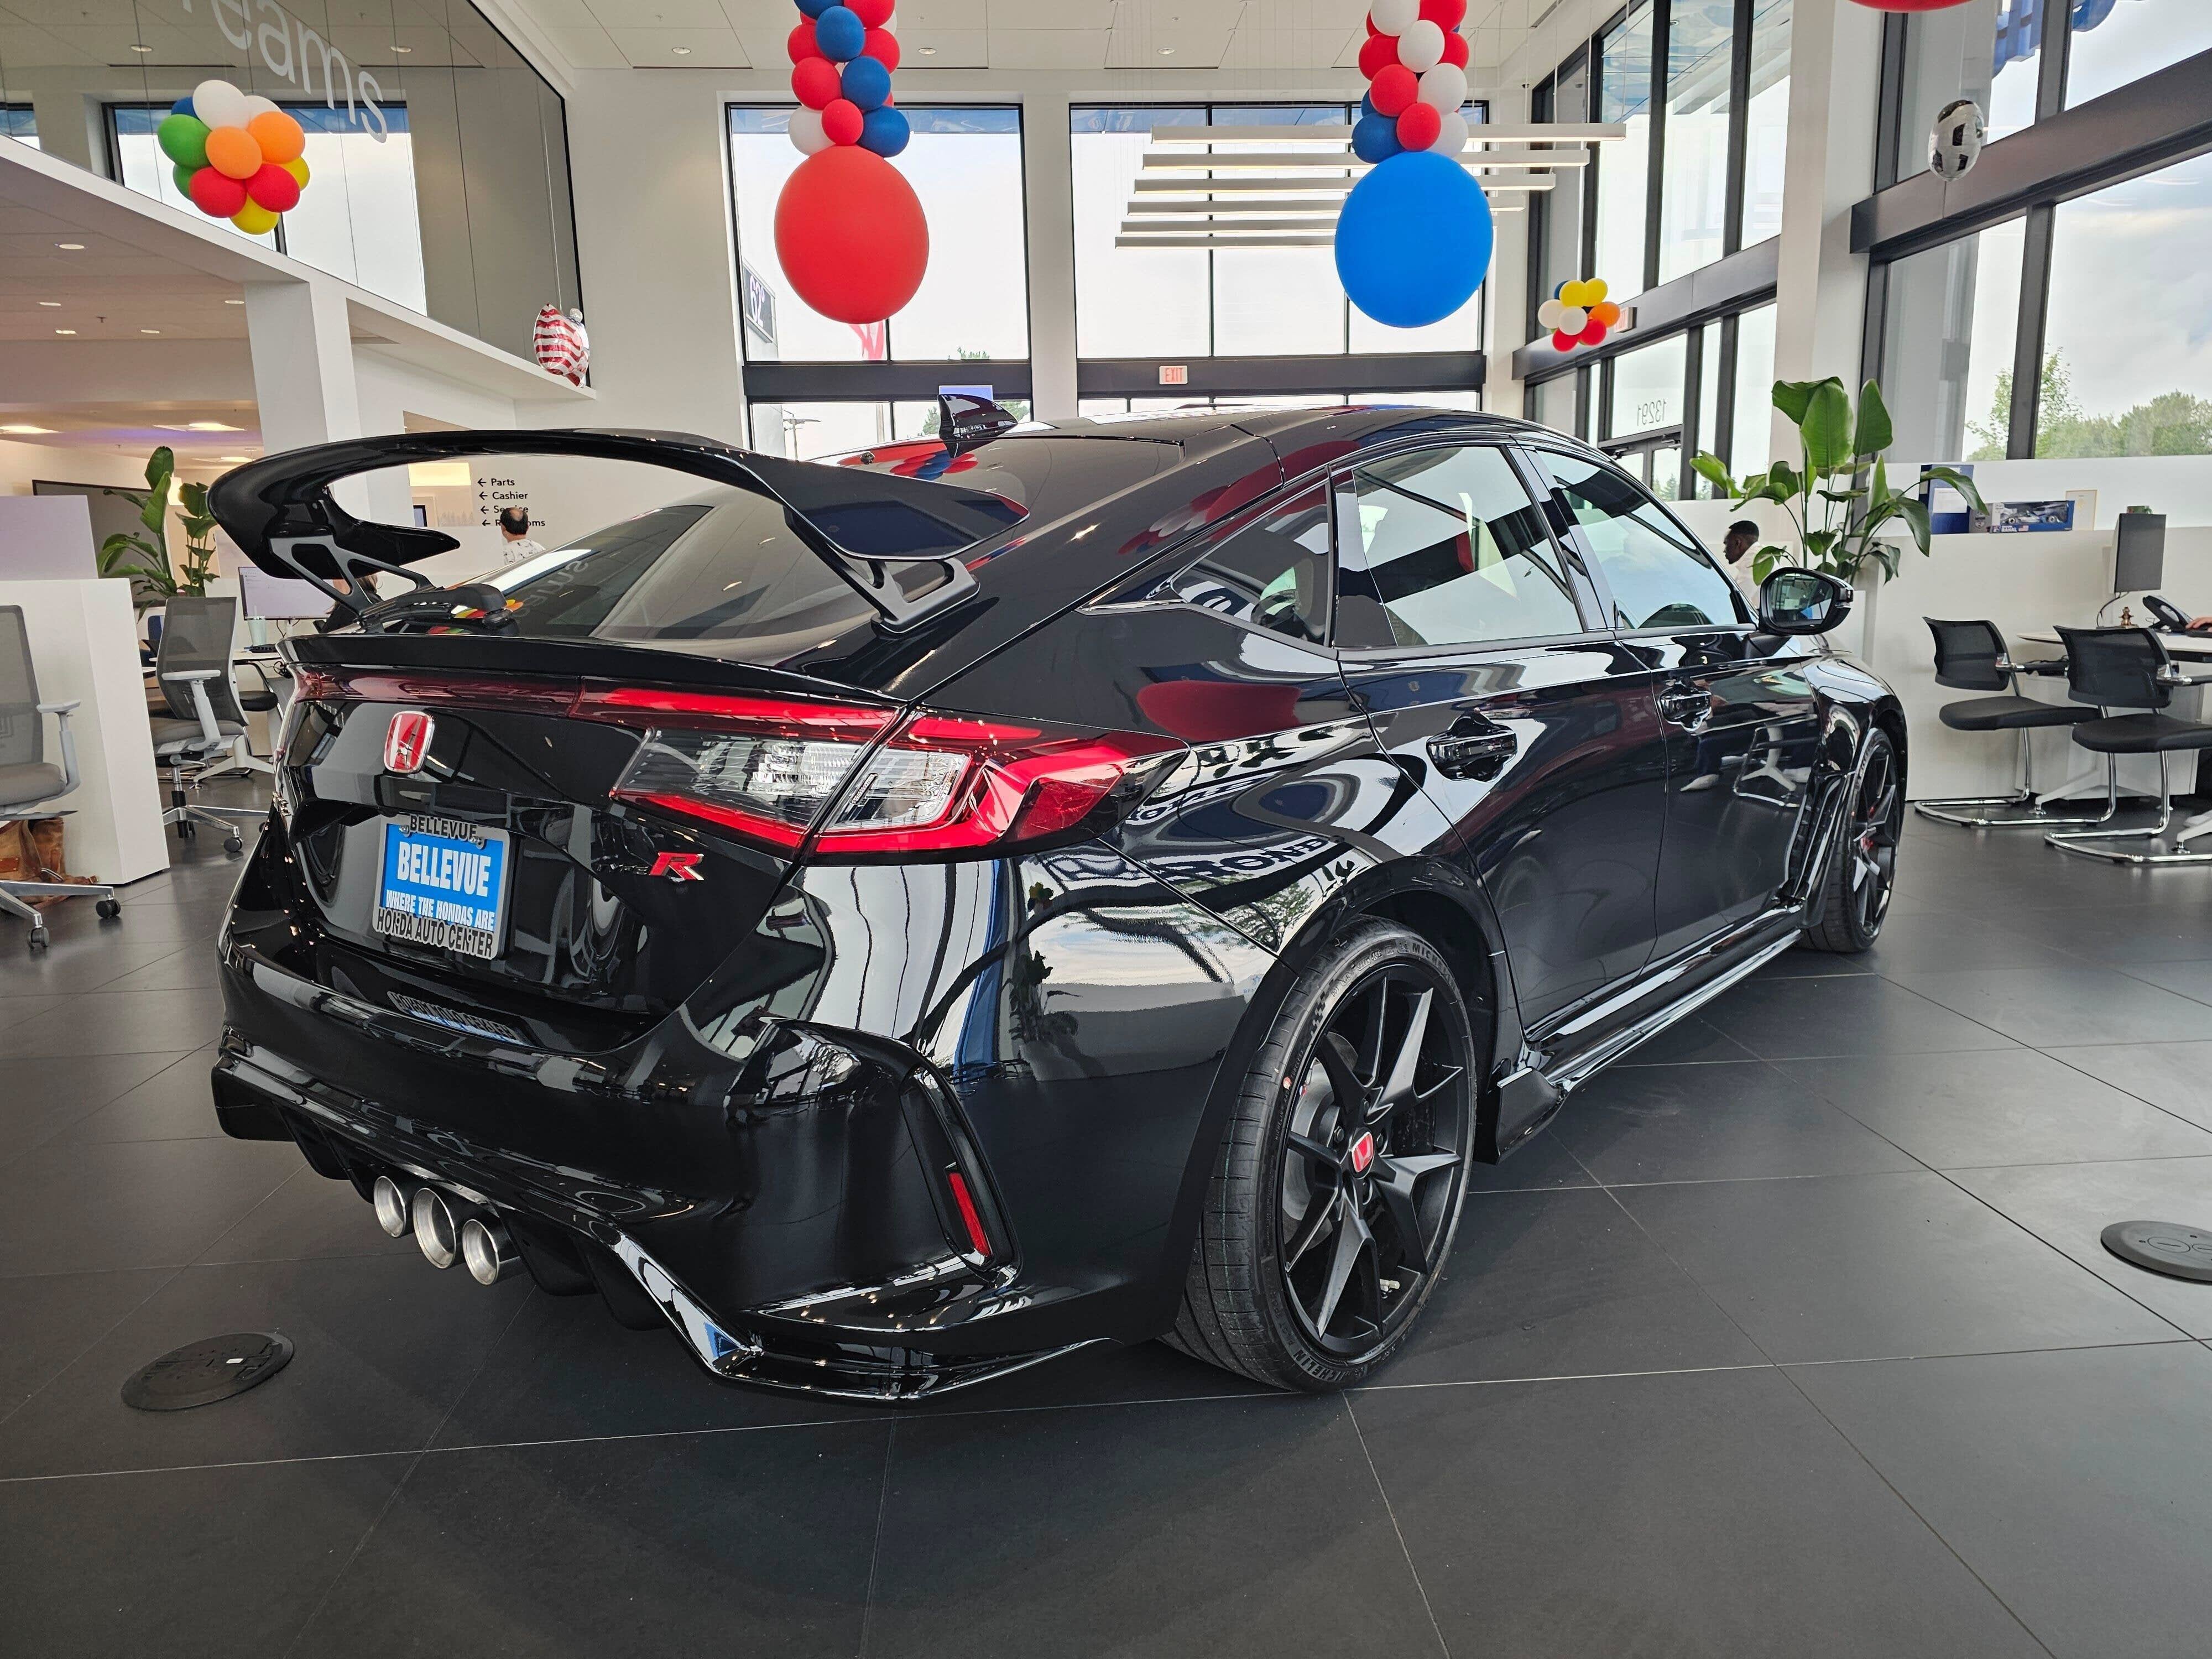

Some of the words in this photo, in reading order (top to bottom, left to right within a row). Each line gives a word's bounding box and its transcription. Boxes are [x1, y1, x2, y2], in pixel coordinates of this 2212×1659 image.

[182, 0, 387, 144] eams
[1165, 367, 1182, 382] EXIT
[492, 491, 528, 499] Cashier
[410, 815, 477, 839] BELLEVUE
[397, 841, 491, 898] BELLEVUE
[649, 852, 705, 880] R
[385, 889, 416, 912] WHERE
[418, 896, 434, 915] THE
[436, 900, 473, 926] HONDAS
[474, 909, 495, 931] ARE
[377, 910, 414, 940] HONDA
[415, 916, 445, 945] AUTO
[448, 924, 493, 958] CENTER
